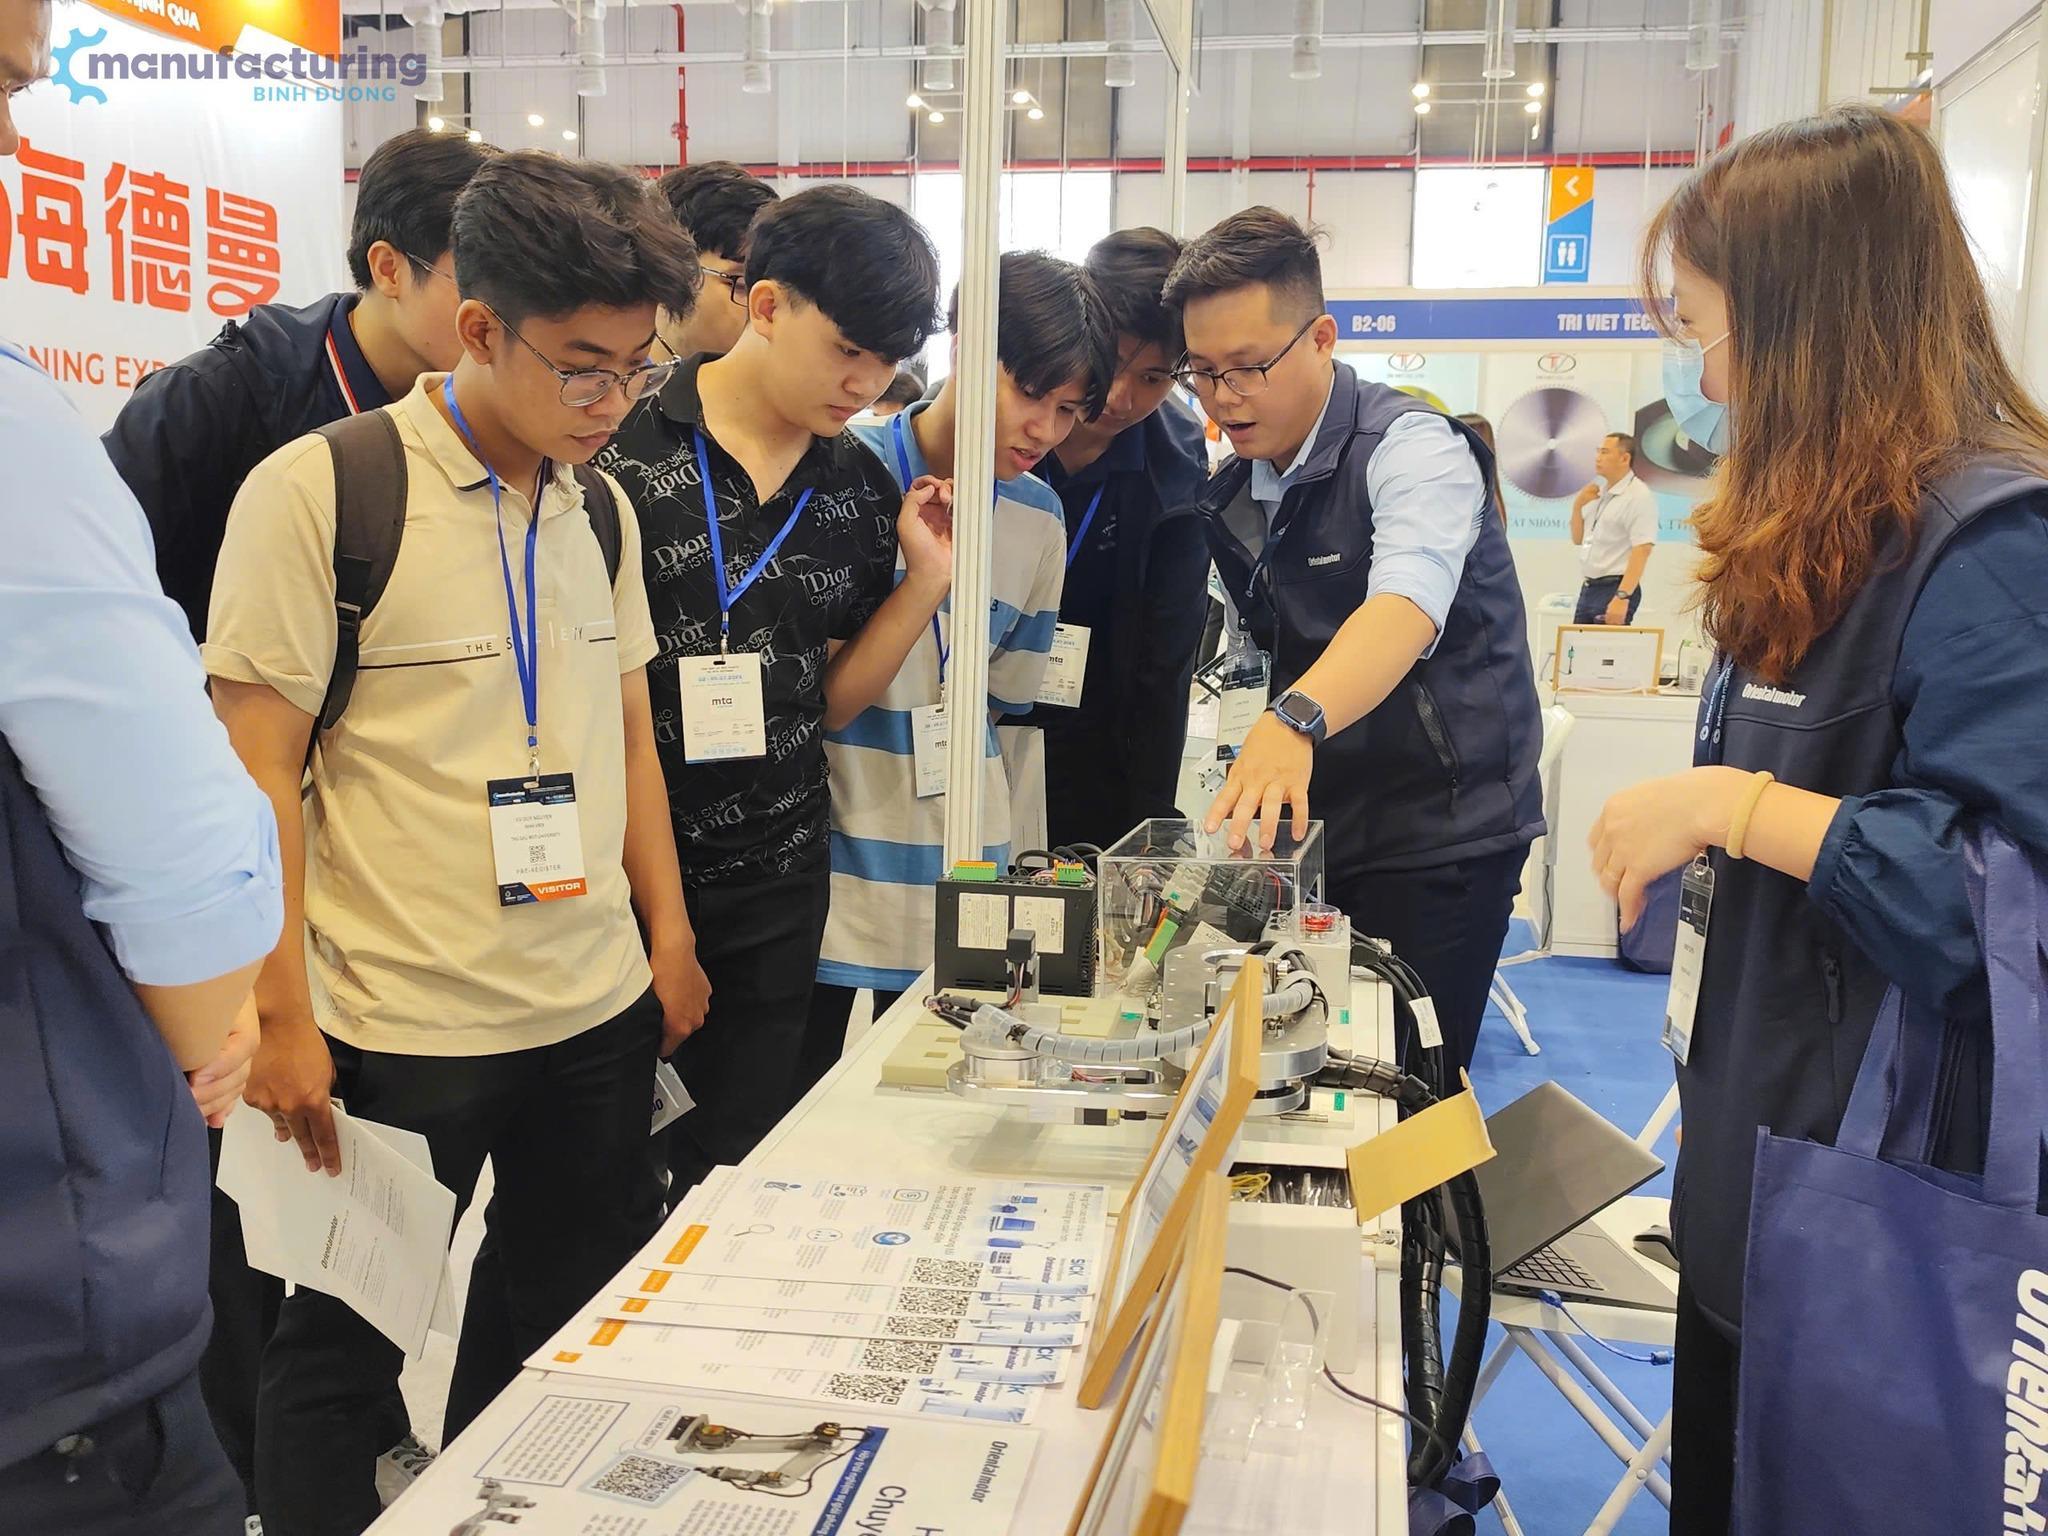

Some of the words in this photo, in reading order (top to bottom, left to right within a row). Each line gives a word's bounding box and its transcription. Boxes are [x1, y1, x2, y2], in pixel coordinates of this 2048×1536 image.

[168, 3, 201, 31] QUA
[1352, 314, 1396, 333] B2-06
[1557, 313, 1582, 331] TRI
[1586, 313, 1620, 331] VIET
[1623, 313, 1656, 331] TEC
[29, 345, 104, 385] NING
[651, 463, 703, 496] Dior
[651, 533, 711, 570] Dior
[659, 550, 714, 583] CHRISTA
[808, 564, 853, 593] Dior
[465, 642, 493, 654] THE
[712, 697, 733, 707] mta
[538, 882, 581, 894] VISITOR
[1068, 1258, 1085, 1276] SICK
[856, 1485, 907, 1536] Chuy
